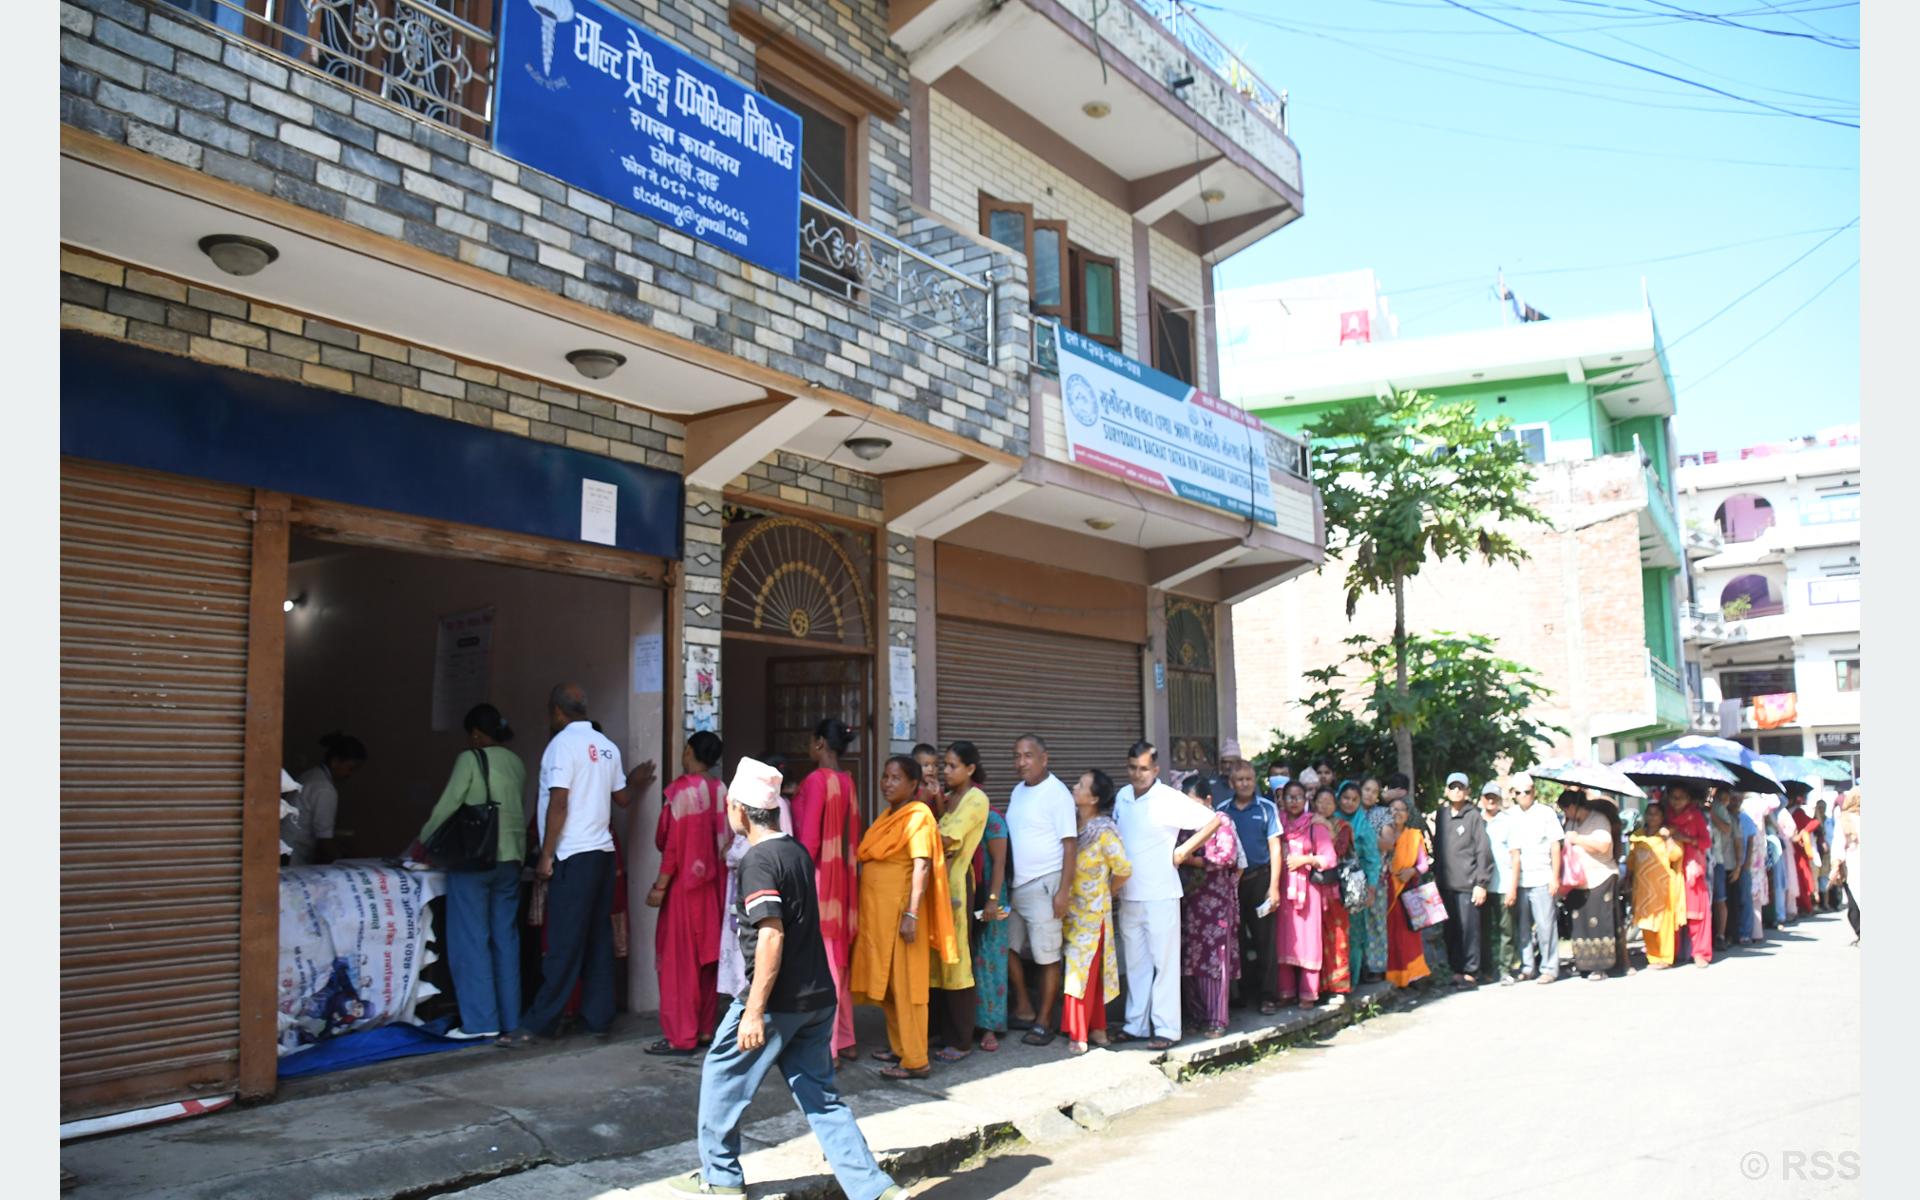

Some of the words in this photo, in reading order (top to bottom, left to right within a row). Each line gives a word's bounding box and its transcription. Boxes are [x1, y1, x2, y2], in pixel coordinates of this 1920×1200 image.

[574, 12, 623, 80] साल्ट
[742, 93, 795, 170] लिमिटेड
[620, 155, 647, 180] फोन
[629, 106, 675, 145] शाखा
[678, 134, 741, 177] कार्यालय
[632, 185, 748, 246] stcdang@gmail.com
